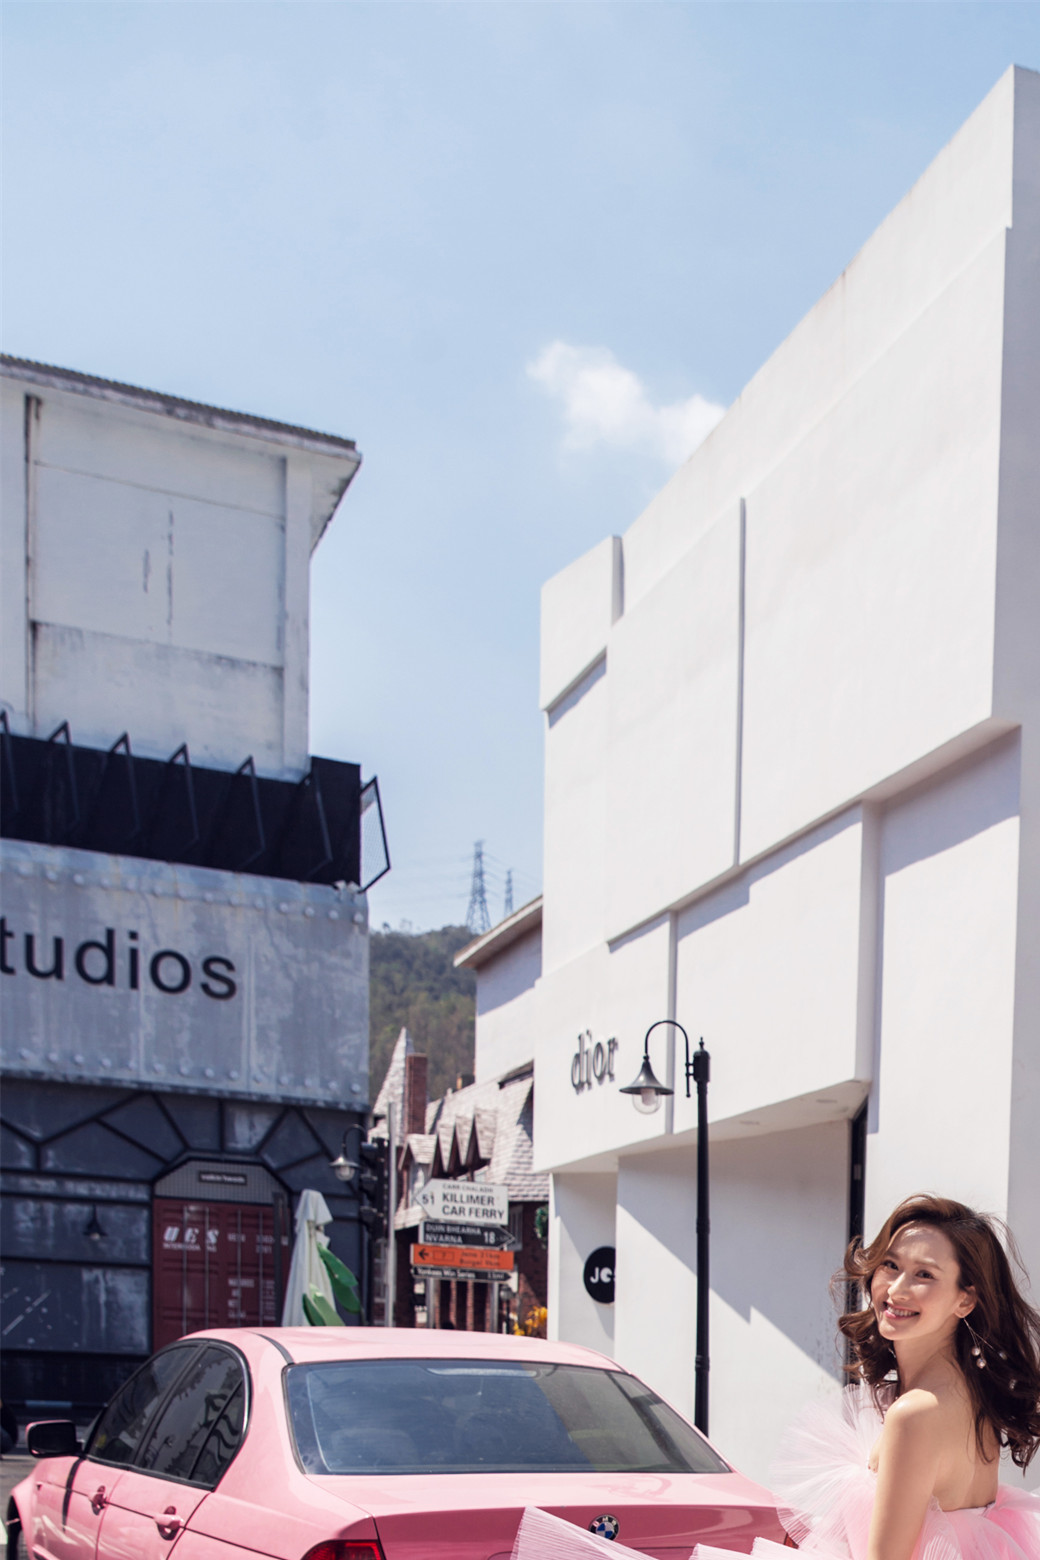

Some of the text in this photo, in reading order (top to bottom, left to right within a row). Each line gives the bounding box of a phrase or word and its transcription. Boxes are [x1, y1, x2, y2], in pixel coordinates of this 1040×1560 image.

[0, 915, 237, 1001] tudios
[571, 1029, 618, 1092] dior
[442, 1193, 495, 1206] KILLIMER
[442, 1205, 505, 1220] CAR FERRY
[483, 1231, 496, 1244] 18
